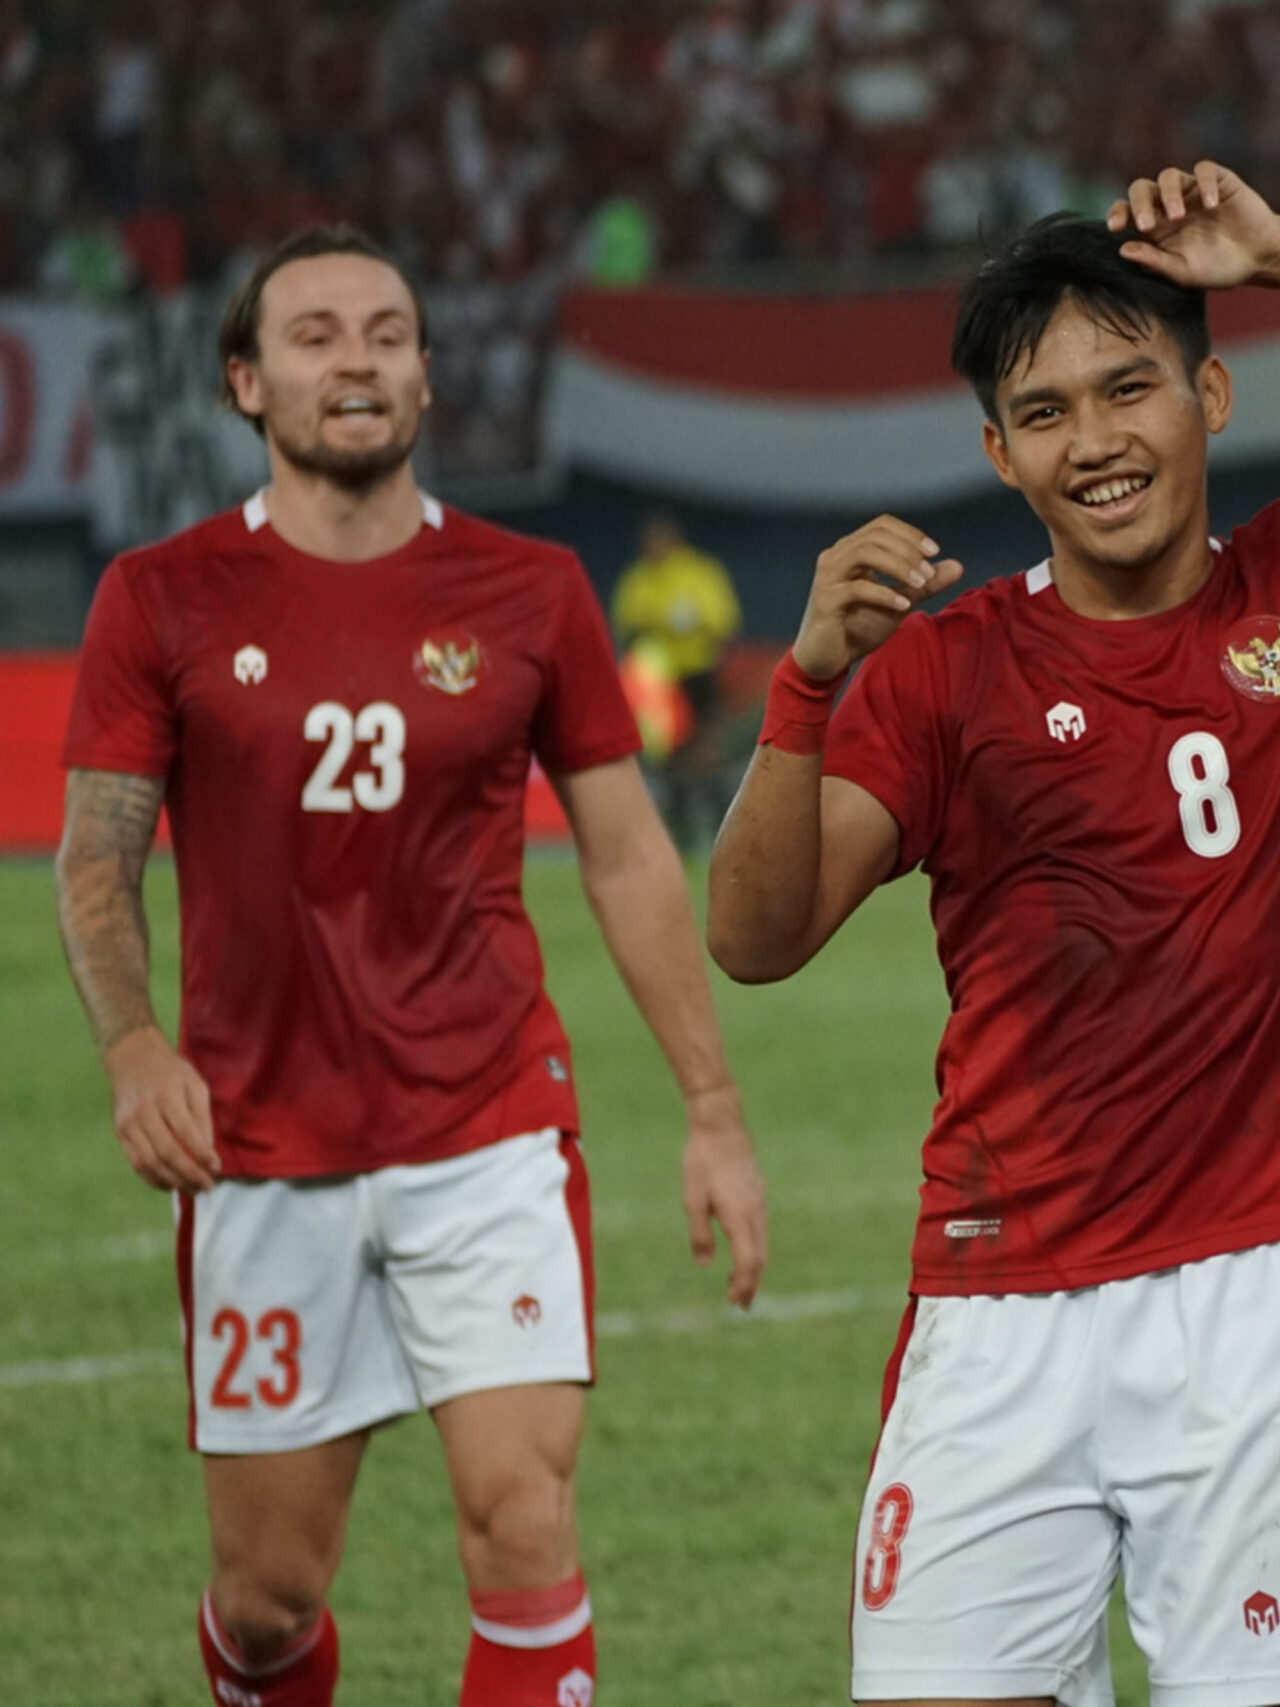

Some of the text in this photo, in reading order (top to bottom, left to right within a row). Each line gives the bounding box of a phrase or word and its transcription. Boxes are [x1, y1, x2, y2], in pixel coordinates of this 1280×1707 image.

[301, 701, 406, 812] 23
[1167, 731, 1242, 859] 8
[209, 1306, 302, 1411] 23
[861, 1481, 913, 1612] 8
